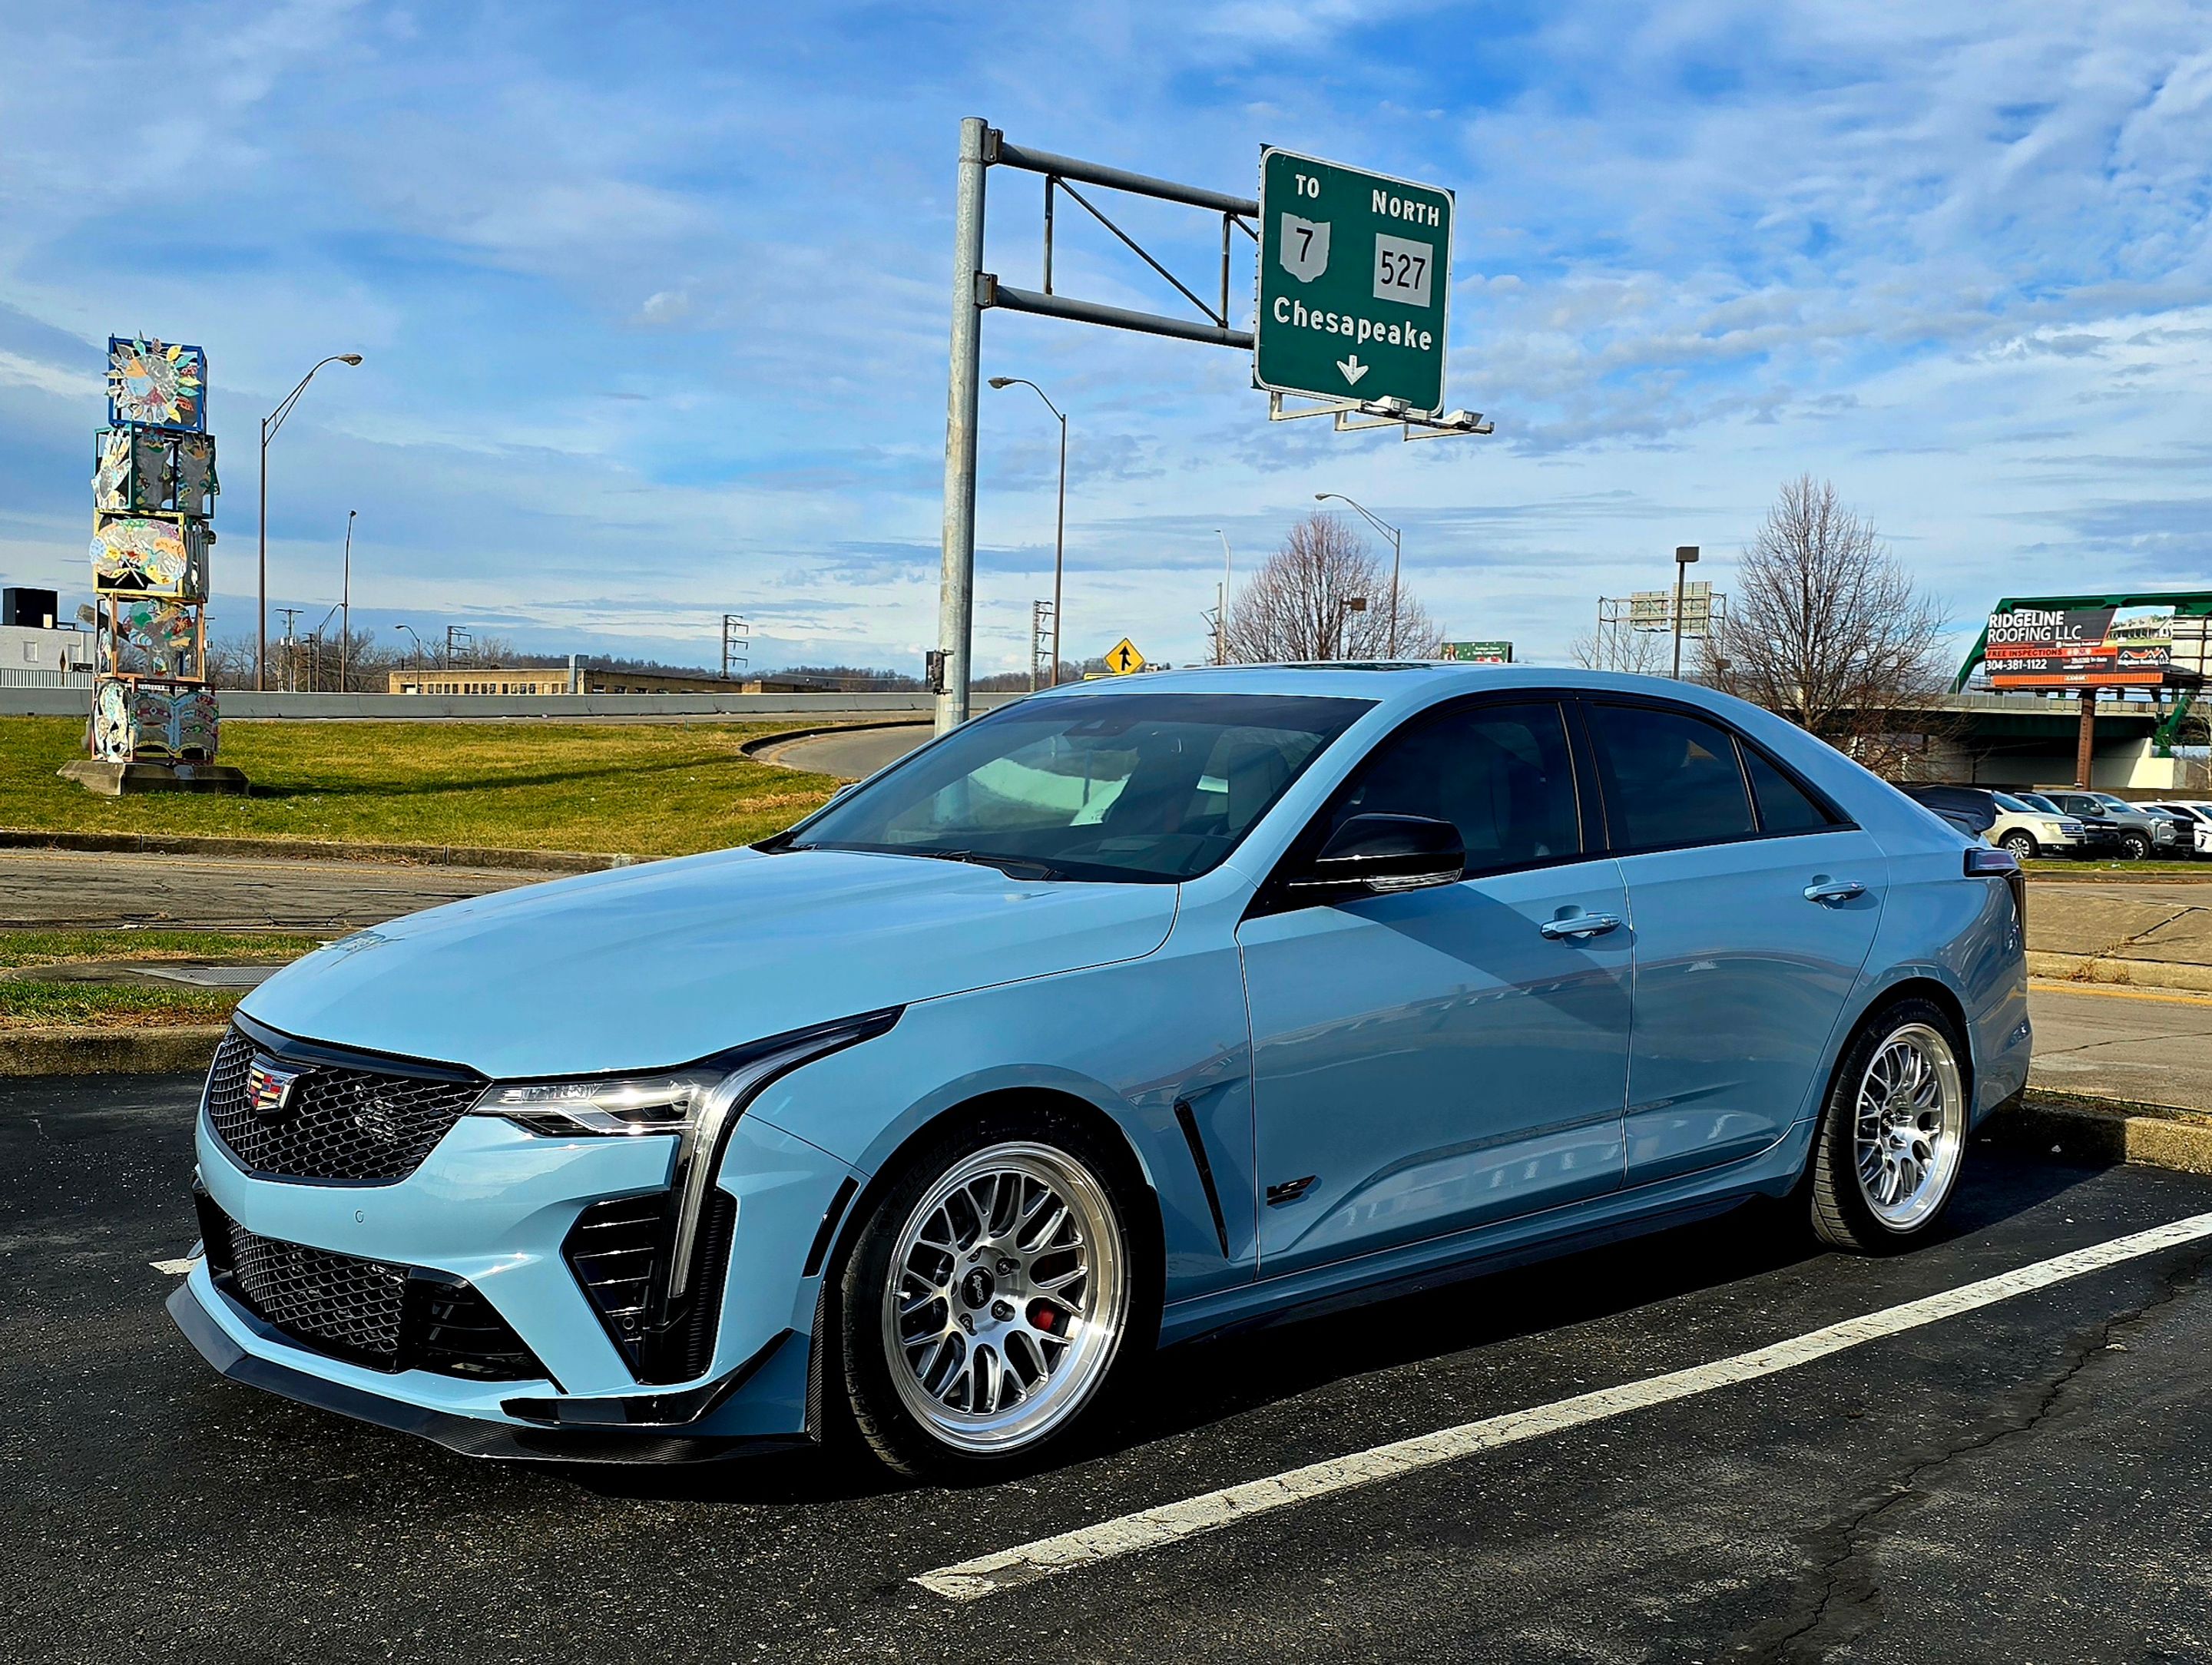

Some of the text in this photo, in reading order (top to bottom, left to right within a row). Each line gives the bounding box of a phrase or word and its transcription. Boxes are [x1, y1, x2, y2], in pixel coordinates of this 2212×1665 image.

[1296, 174, 1320, 198] TO
[1372, 190, 1439, 227] NORTH
[1296, 227, 1313, 262] 7
[1381, 251, 1426, 290] 527
[1273, 296, 1432, 350] Chesapeake
[1987, 624, 2082, 642] ROOFING LLC
[1988, 611, 2065, 628] RIDGELINE
[1986, 659, 2048, 670] 304-381-1122
